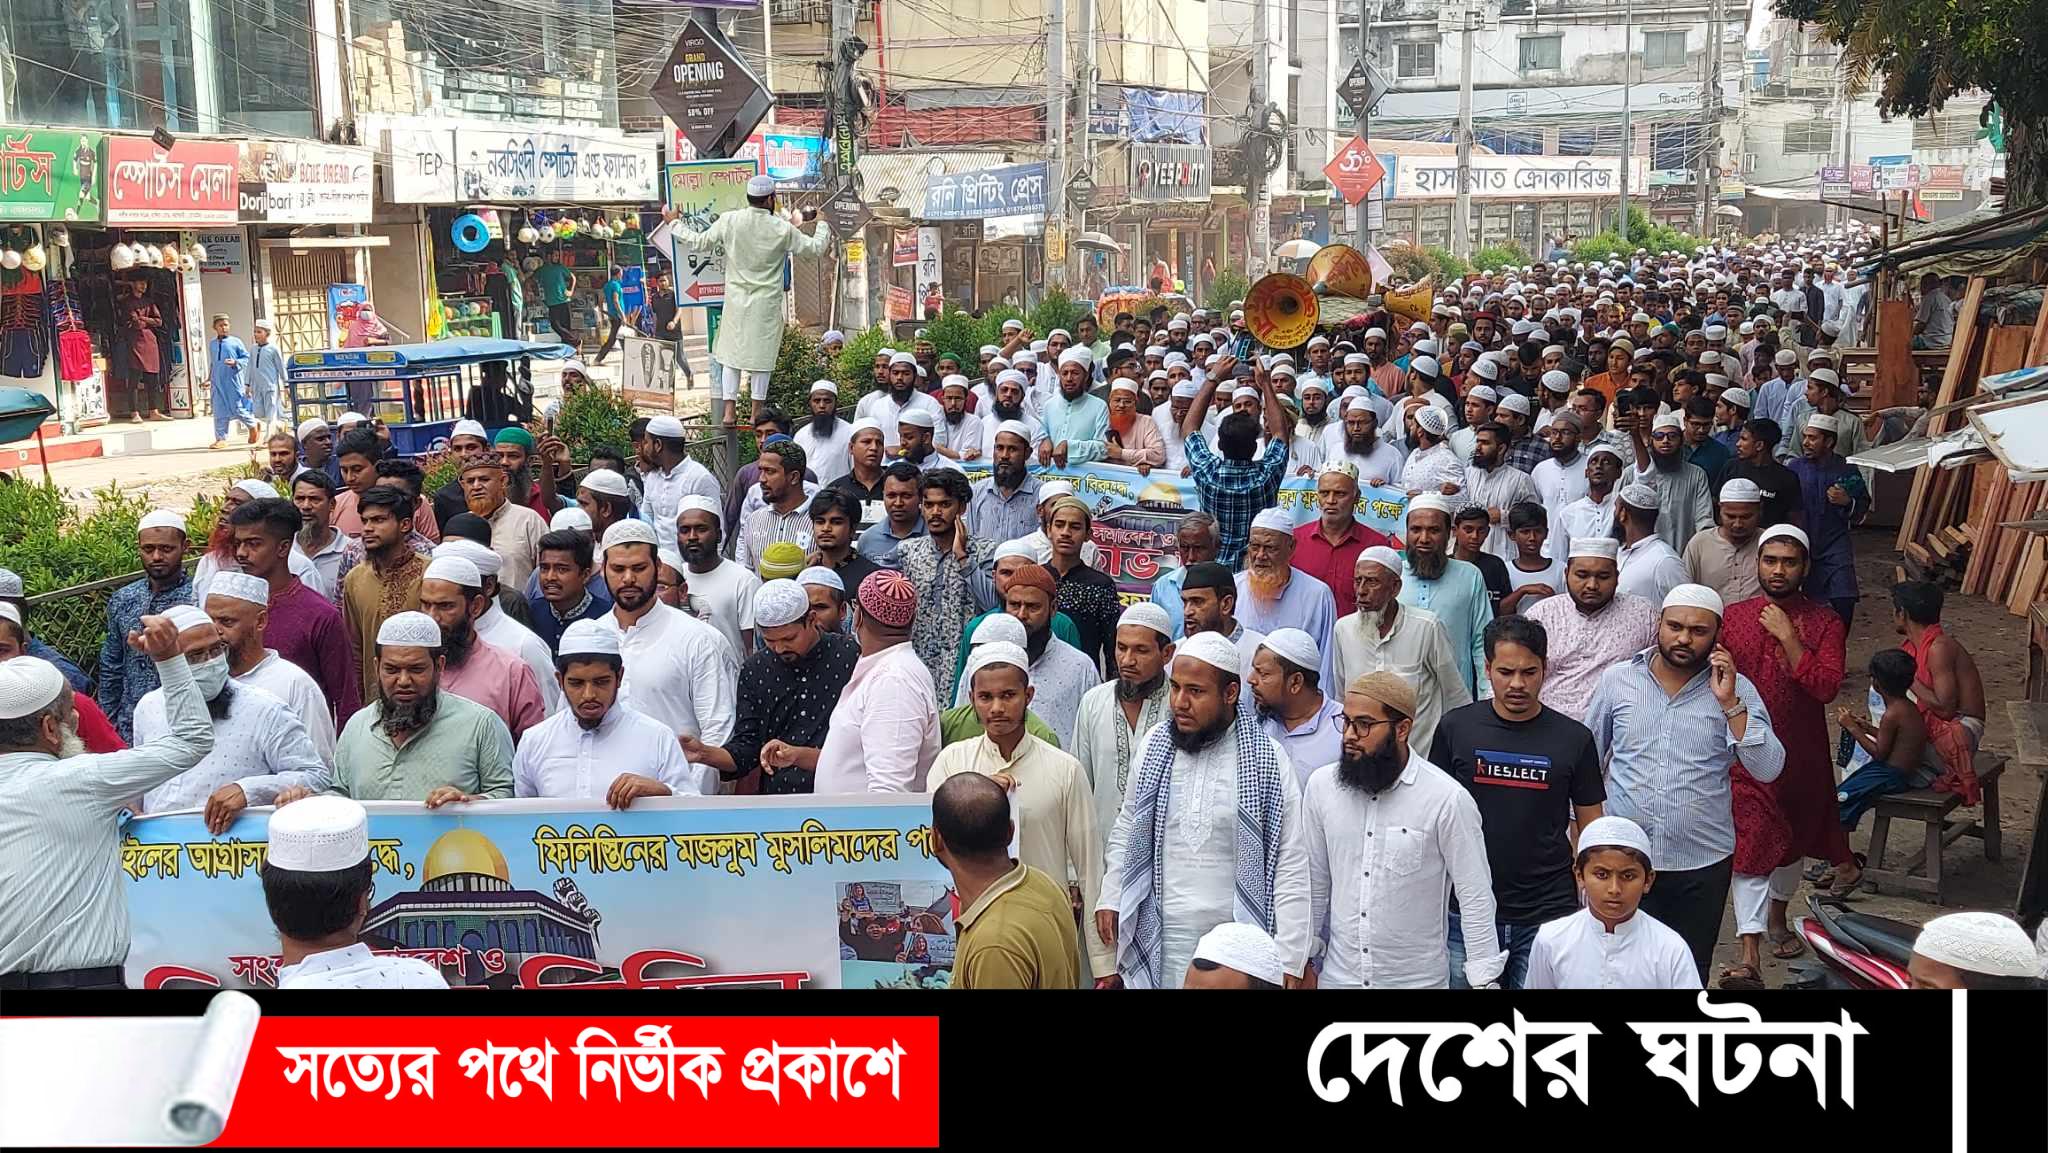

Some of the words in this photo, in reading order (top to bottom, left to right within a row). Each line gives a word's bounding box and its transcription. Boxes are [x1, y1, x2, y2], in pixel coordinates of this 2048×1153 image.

[673, 61, 725, 83] OPENING
[112, 150, 185, 200] স্পোর্টস
[189, 163, 234, 201] মেলা
[416, 151, 443, 177] TEP
[486, 138, 535, 181] নরসিংদী
[537, 143, 578, 179] স্পোর্টস
[603, 154, 637, 180] ফ্যাশন
[1514, 160, 1613, 191] ক্রোকারিজ
[931, 176, 959, 210] রনি
[961, 173, 1006, 210] প্রিন্টিং
[1011, 174, 1043, 204] প্রেস
[533, 823, 670, 875] ফিলিস্তিনের
[672, 831, 760, 877] মজলুম
[763, 818, 901, 874] মুসলিমদের
